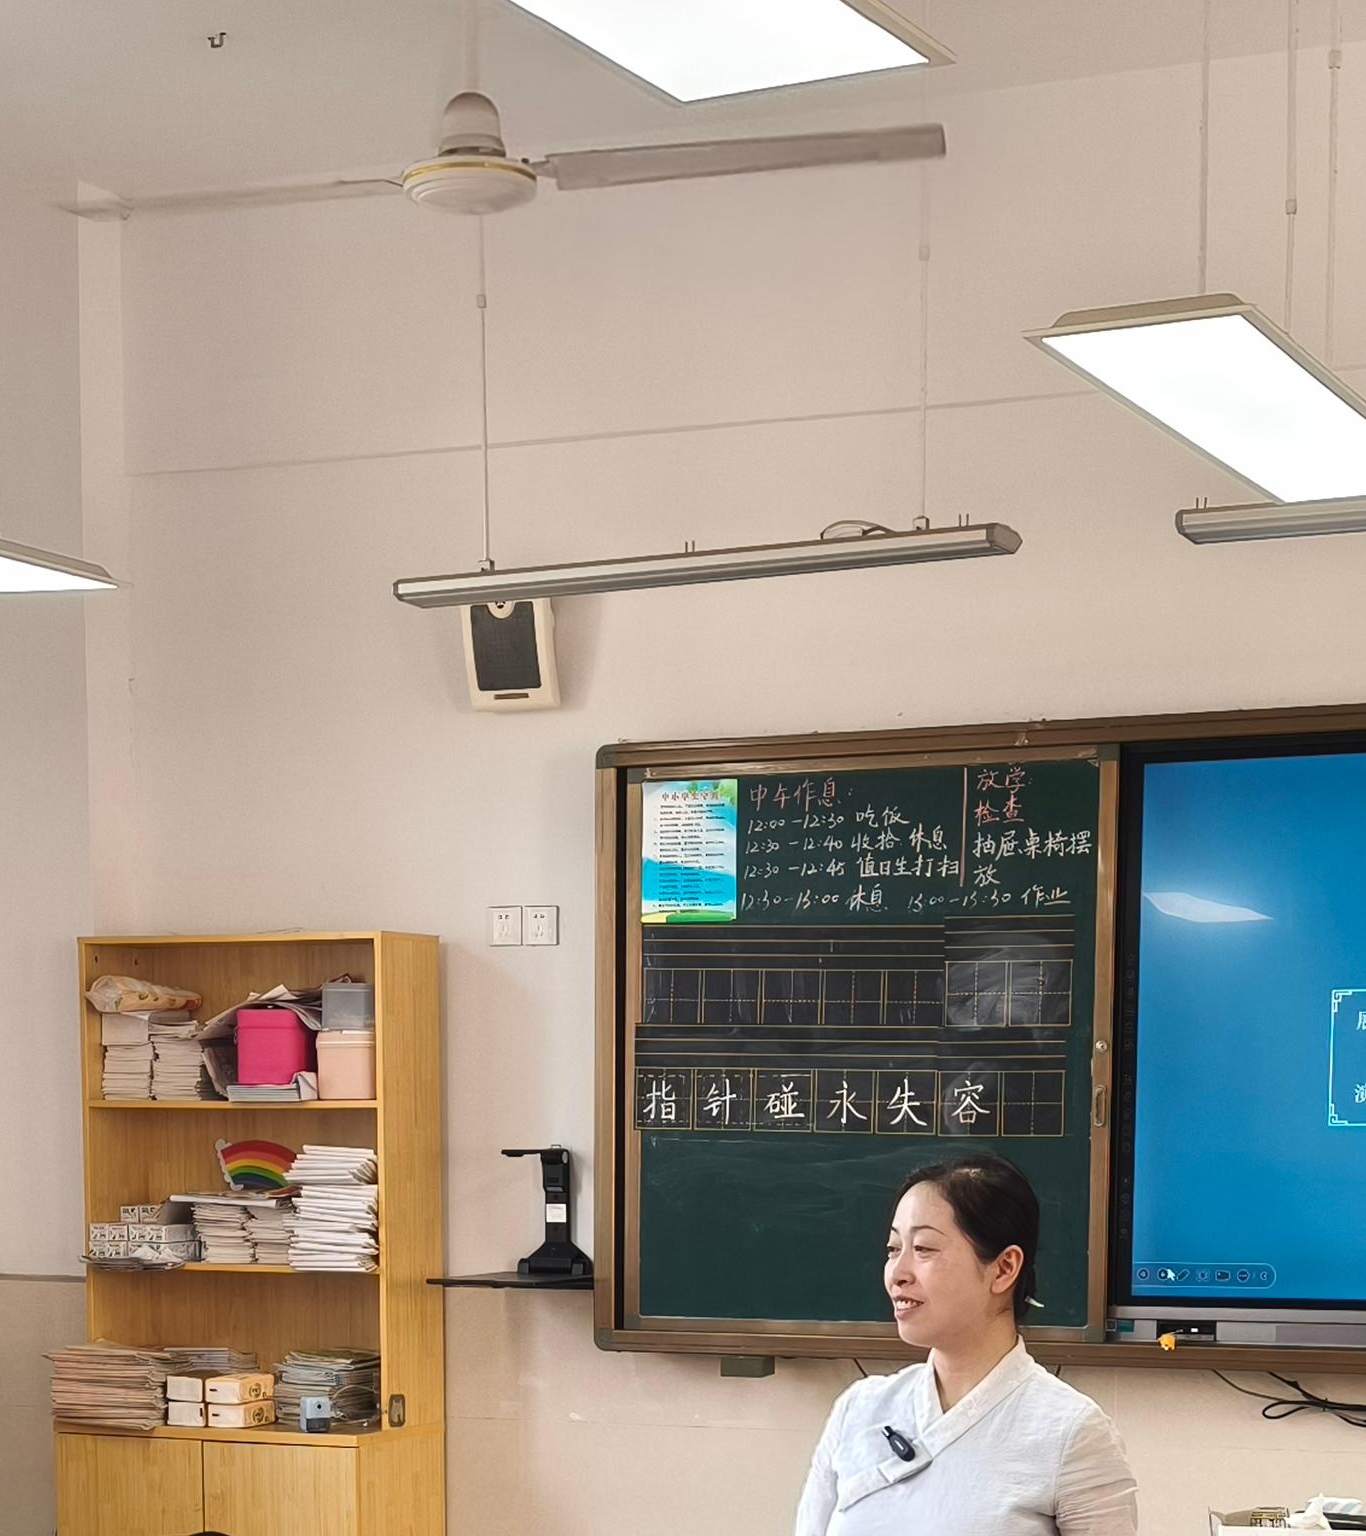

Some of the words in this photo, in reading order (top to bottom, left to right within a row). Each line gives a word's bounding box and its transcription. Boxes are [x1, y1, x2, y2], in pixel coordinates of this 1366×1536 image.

[855, 804, 910, 828] 吃饭
[974, 794, 1025, 827] 检查
[856, 852, 960, 878] 值日生打扫
[1020, 883, 1072, 908] 作业
